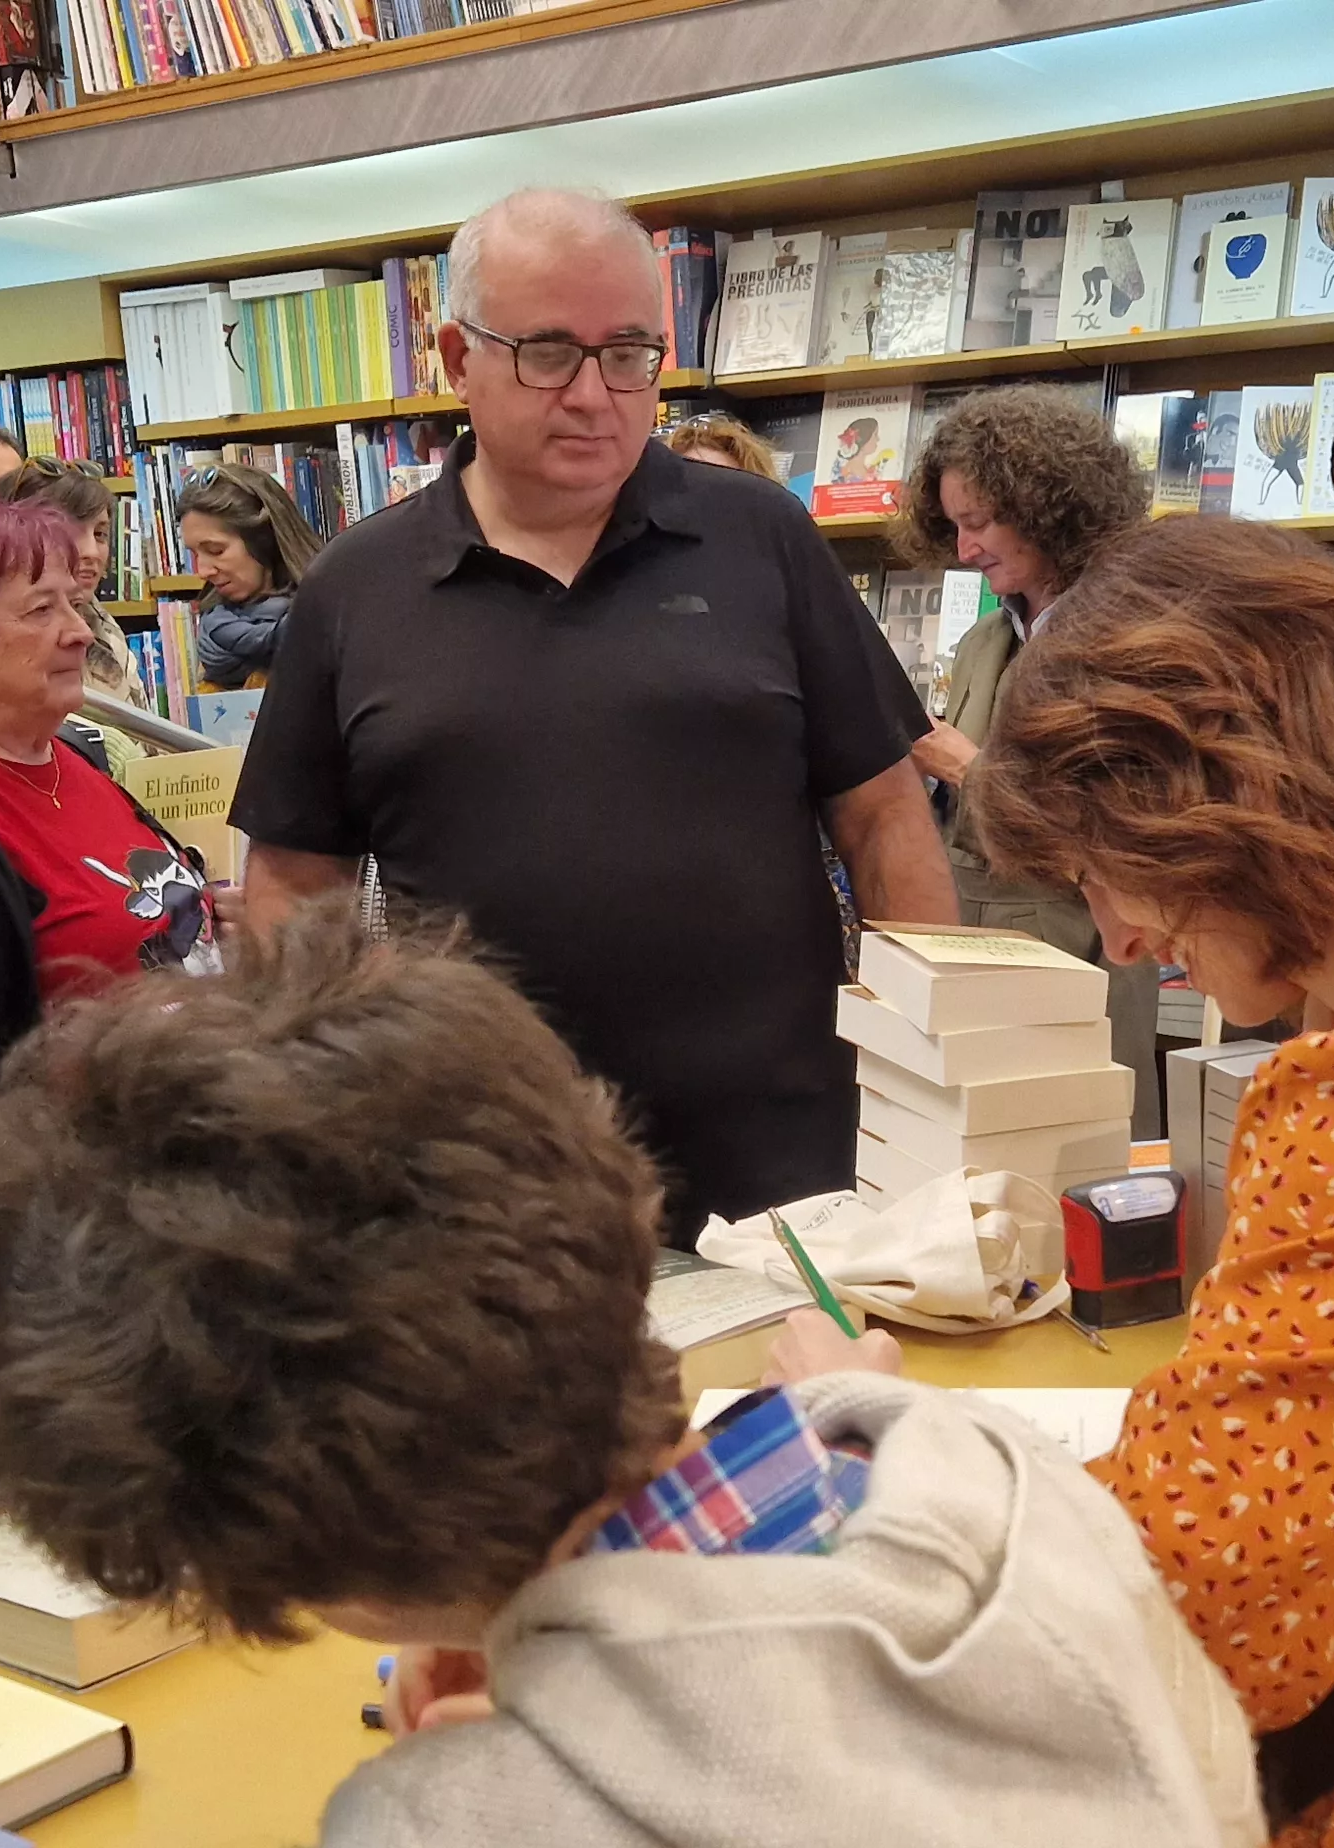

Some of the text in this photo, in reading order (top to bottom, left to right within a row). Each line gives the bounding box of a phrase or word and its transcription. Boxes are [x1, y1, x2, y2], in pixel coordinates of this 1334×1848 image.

[730, 263, 814, 286] LIBRO DE LAS
[727, 276, 813, 300] PREGUNTAS
[389, 303, 400, 349] COMIC
[836, 395, 899, 409] BORDADORA
[145, 773, 220, 799] El infinito
[161, 803, 180, 820] un
[185, 799, 225, 821] junco
